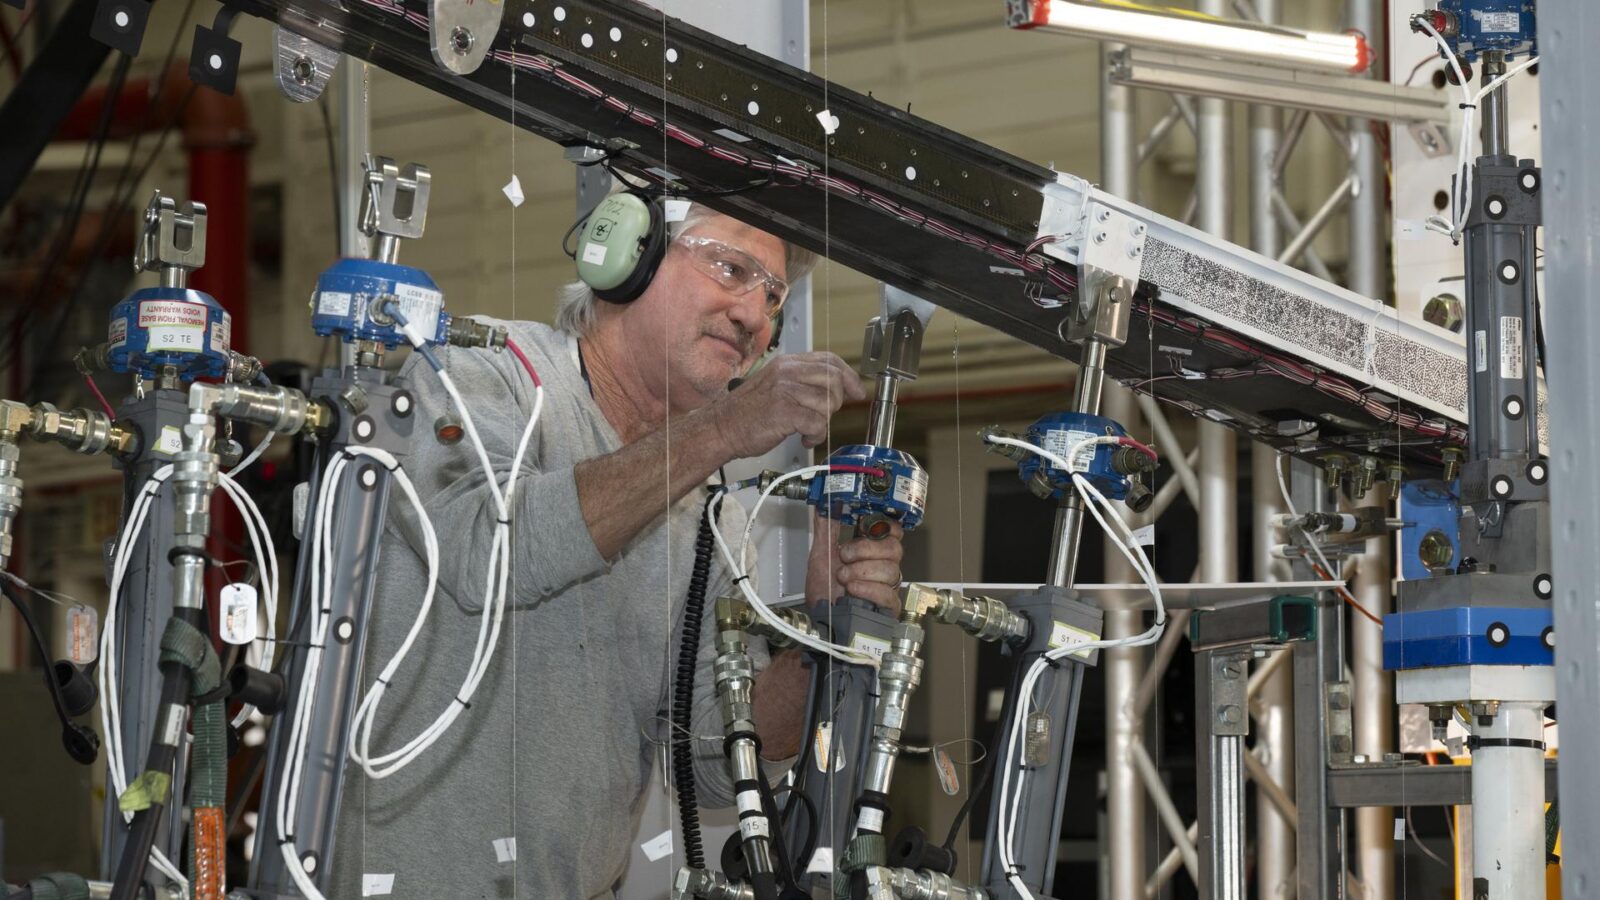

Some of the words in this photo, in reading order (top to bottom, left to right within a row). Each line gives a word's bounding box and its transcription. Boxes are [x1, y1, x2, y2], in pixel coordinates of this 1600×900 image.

[146, 306, 181, 314] WARRANTY
[183, 307, 200, 316] VOIDS
[162, 335, 175, 343] S2
[181, 335, 191, 344] TE
[170, 439, 181, 449] S2
[874, 647, 882, 657] TE
